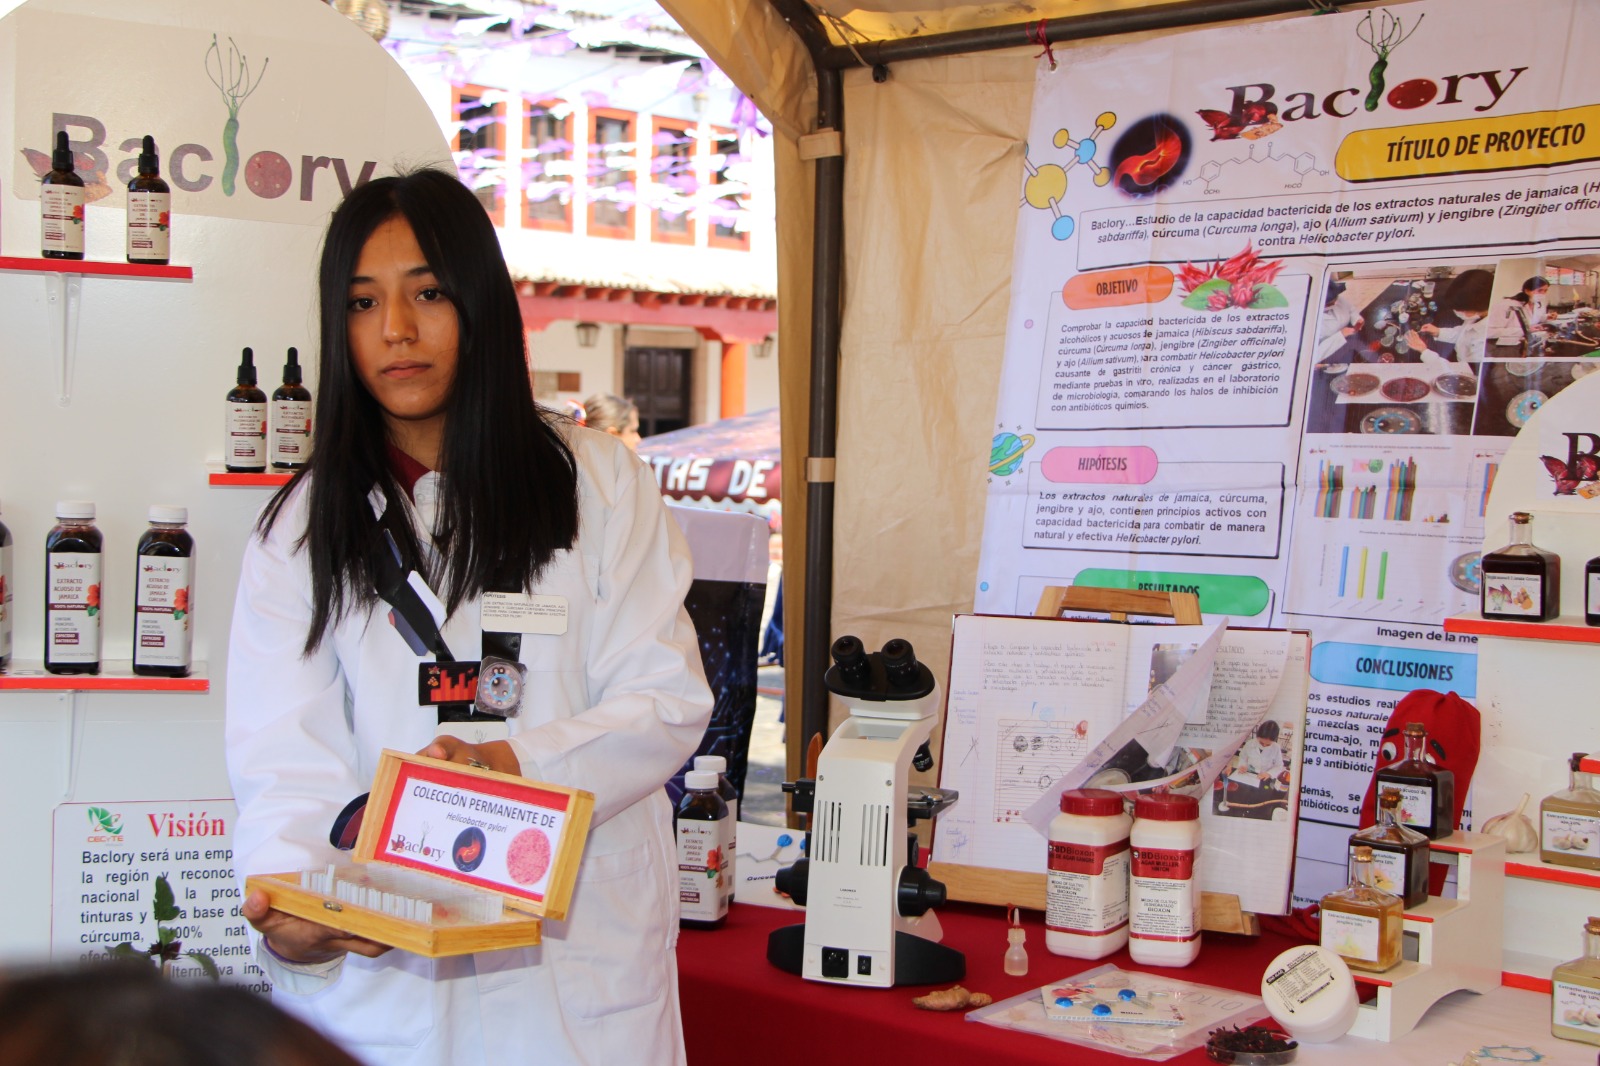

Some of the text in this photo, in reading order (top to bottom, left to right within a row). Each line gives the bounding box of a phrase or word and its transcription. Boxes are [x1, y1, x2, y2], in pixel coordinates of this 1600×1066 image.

[1226, 52, 1528, 127] Baclory
[1387, 122, 1585, 162] TÍTULO DE PROYECTO
[1178, 213, 1191, 223] de
[1194, 212, 1203, 222] la
[1206, 207, 1264, 223] capacidad
[1267, 203, 1332, 216] bactericida
[1334, 202, 1349, 213] de
[1352, 201, 1371, 211] los
[1374, 197, 1434, 210] extractos
[1438, 191, 1500, 205] naturales
[1505, 189, 1522, 200] de
[1525, 185, 1578, 201] jamaica
[1151, 227, 1199, 238] cúrcuma
[1202, 224, 1257, 238] (Curcuma
[1260, 220, 1300, 233] longa),
[1303, 218, 1321, 231] ajo
[1325, 216, 1367, 231] (Allium
[1369, 211, 1424, 225] sativum)
[1427, 212, 1435, 223] y
[1437, 207, 1494, 223] jengibre
[1498, 202, 1562, 219] (Zingiber
[1258, 226, 1414, 246] contra Helicobacter pylori.
[1096, 279, 1138, 296] OBJETIVO
[1078, 454, 1128, 471] HIPÓTESIS
[727, 459, 775, 498] DE
[1039, 491, 1267, 504] Los extractos de jamaica, cúrcuma,
[1035, 503, 1266, 518] jengibre y ajo, principios activos con
[1035, 517, 1265, 532] capacidad bactericida para combatir de manera
[1033, 530, 1201, 546] natural y efectiva pylori.
[1376, 626, 1442, 641] Imagen de
[1356, 656, 1454, 681] CONCLUSIONES
[1326, 694, 1371, 706] estudios
[1317, 720, 1359, 731] mezclas
[1321, 746, 1367, 759] combatir
[1315, 756, 1321, 766] 9
[1348, 793, 1361, 801] se
[413, 785, 556, 828] COLECCIÓN PERMANENTE DE
[147, 811, 226, 838] Visión
[446, 811, 507, 833] Helicobacter pylori
[82, 849, 199, 865] Baclory será una
[82, 869, 149, 886] la región
[81, 887, 197, 903] nacional la
[80, 906, 225, 924] tinturas y base
[80, 928, 144, 944] cúrcuma,
[188, 944, 251, 957] excelente
